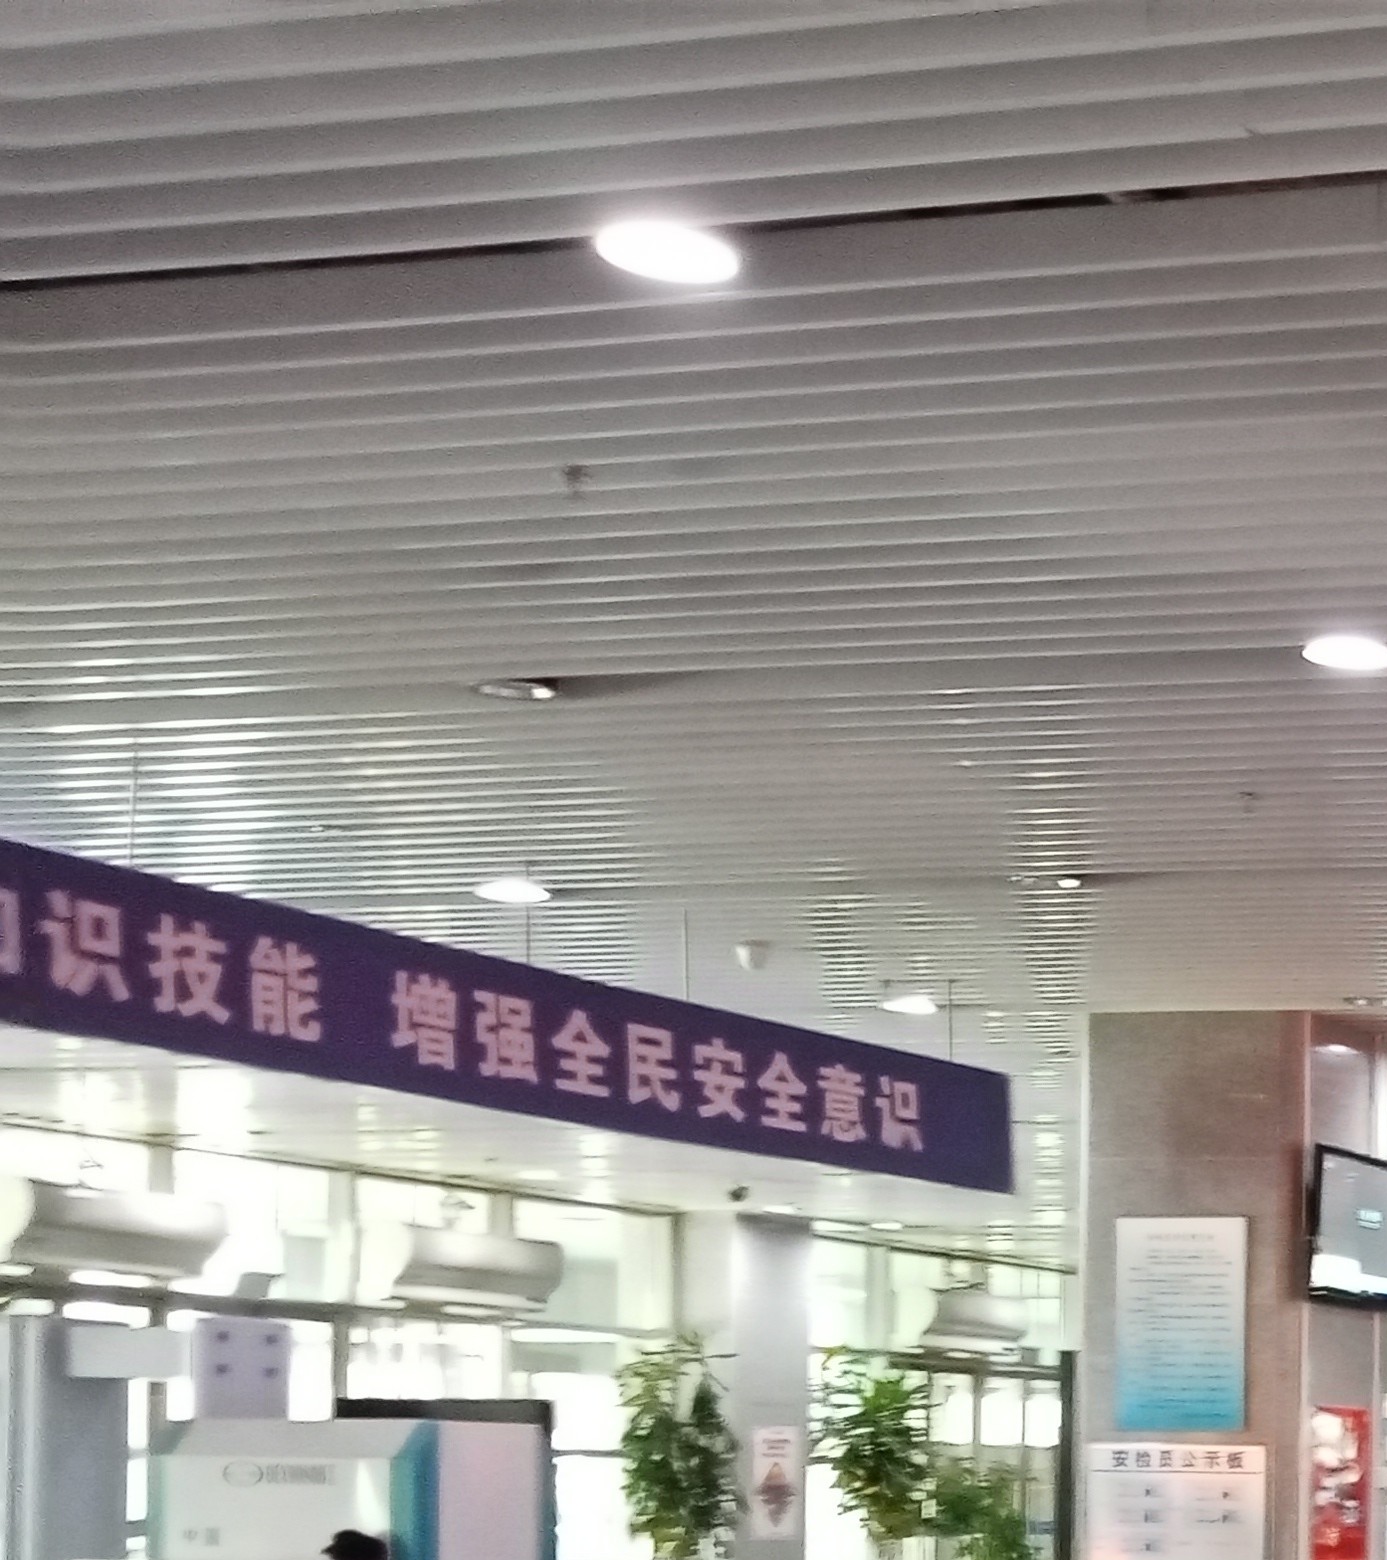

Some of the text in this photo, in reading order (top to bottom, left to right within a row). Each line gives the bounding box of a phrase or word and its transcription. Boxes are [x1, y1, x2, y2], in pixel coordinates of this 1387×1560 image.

[390, 970, 926, 1153] 增强全民安全意识
